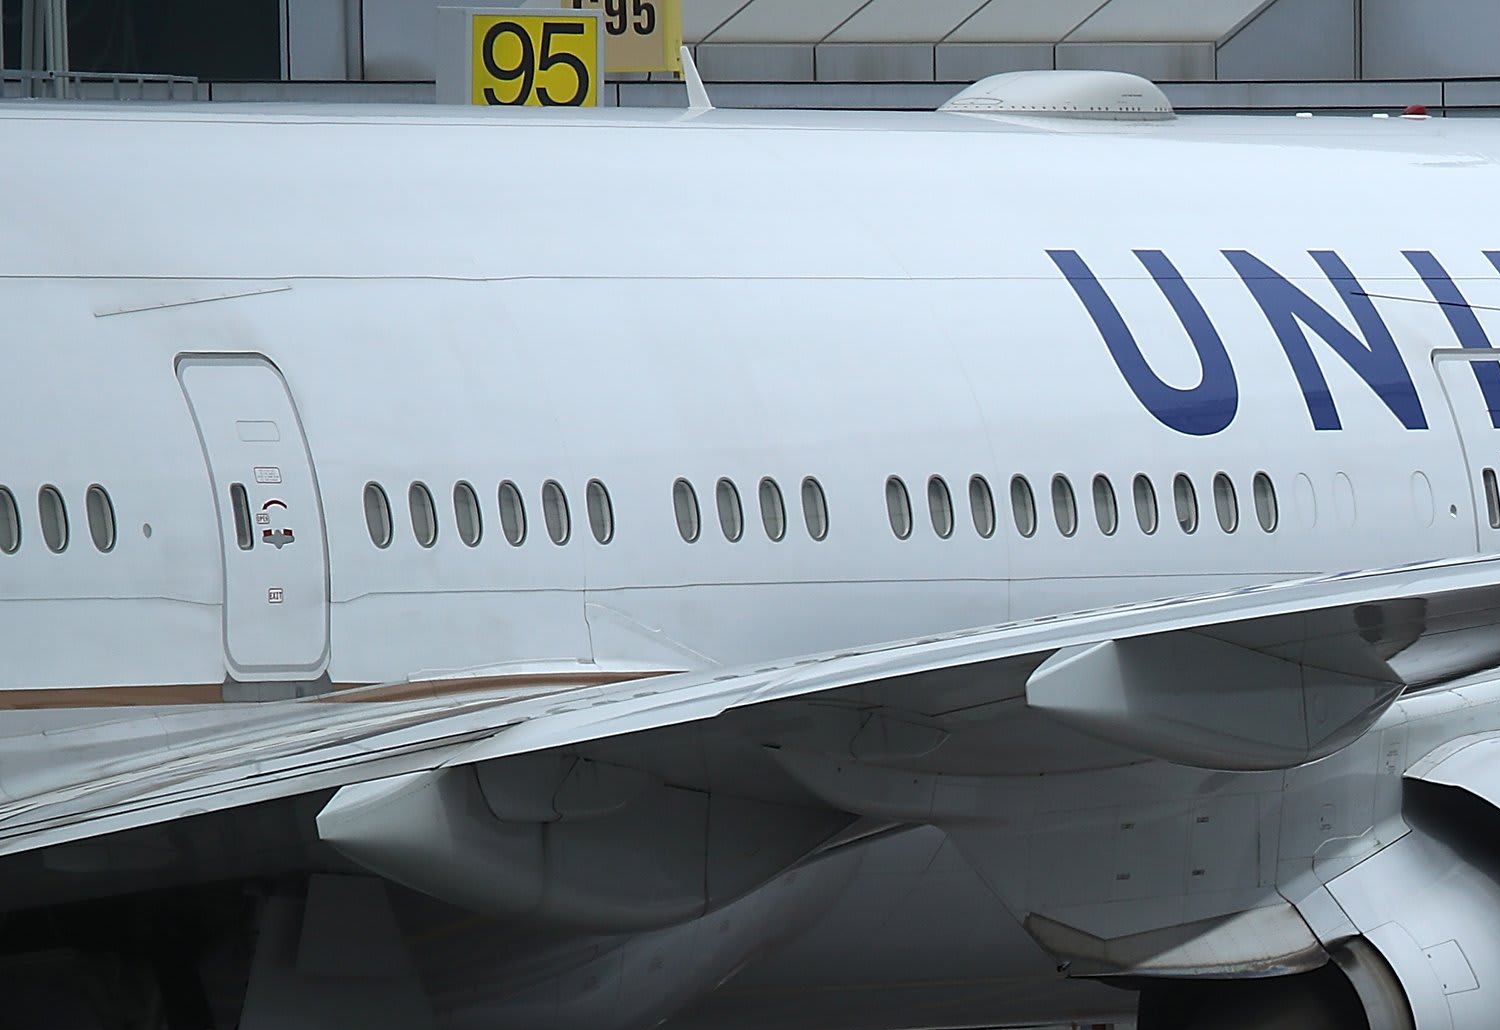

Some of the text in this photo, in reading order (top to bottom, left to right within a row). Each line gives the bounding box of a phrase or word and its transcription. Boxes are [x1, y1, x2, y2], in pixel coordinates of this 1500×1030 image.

[573, 0, 655, 35] -95
[482, 21, 590, 107] 95
[269, 591, 283, 600] EXIT
